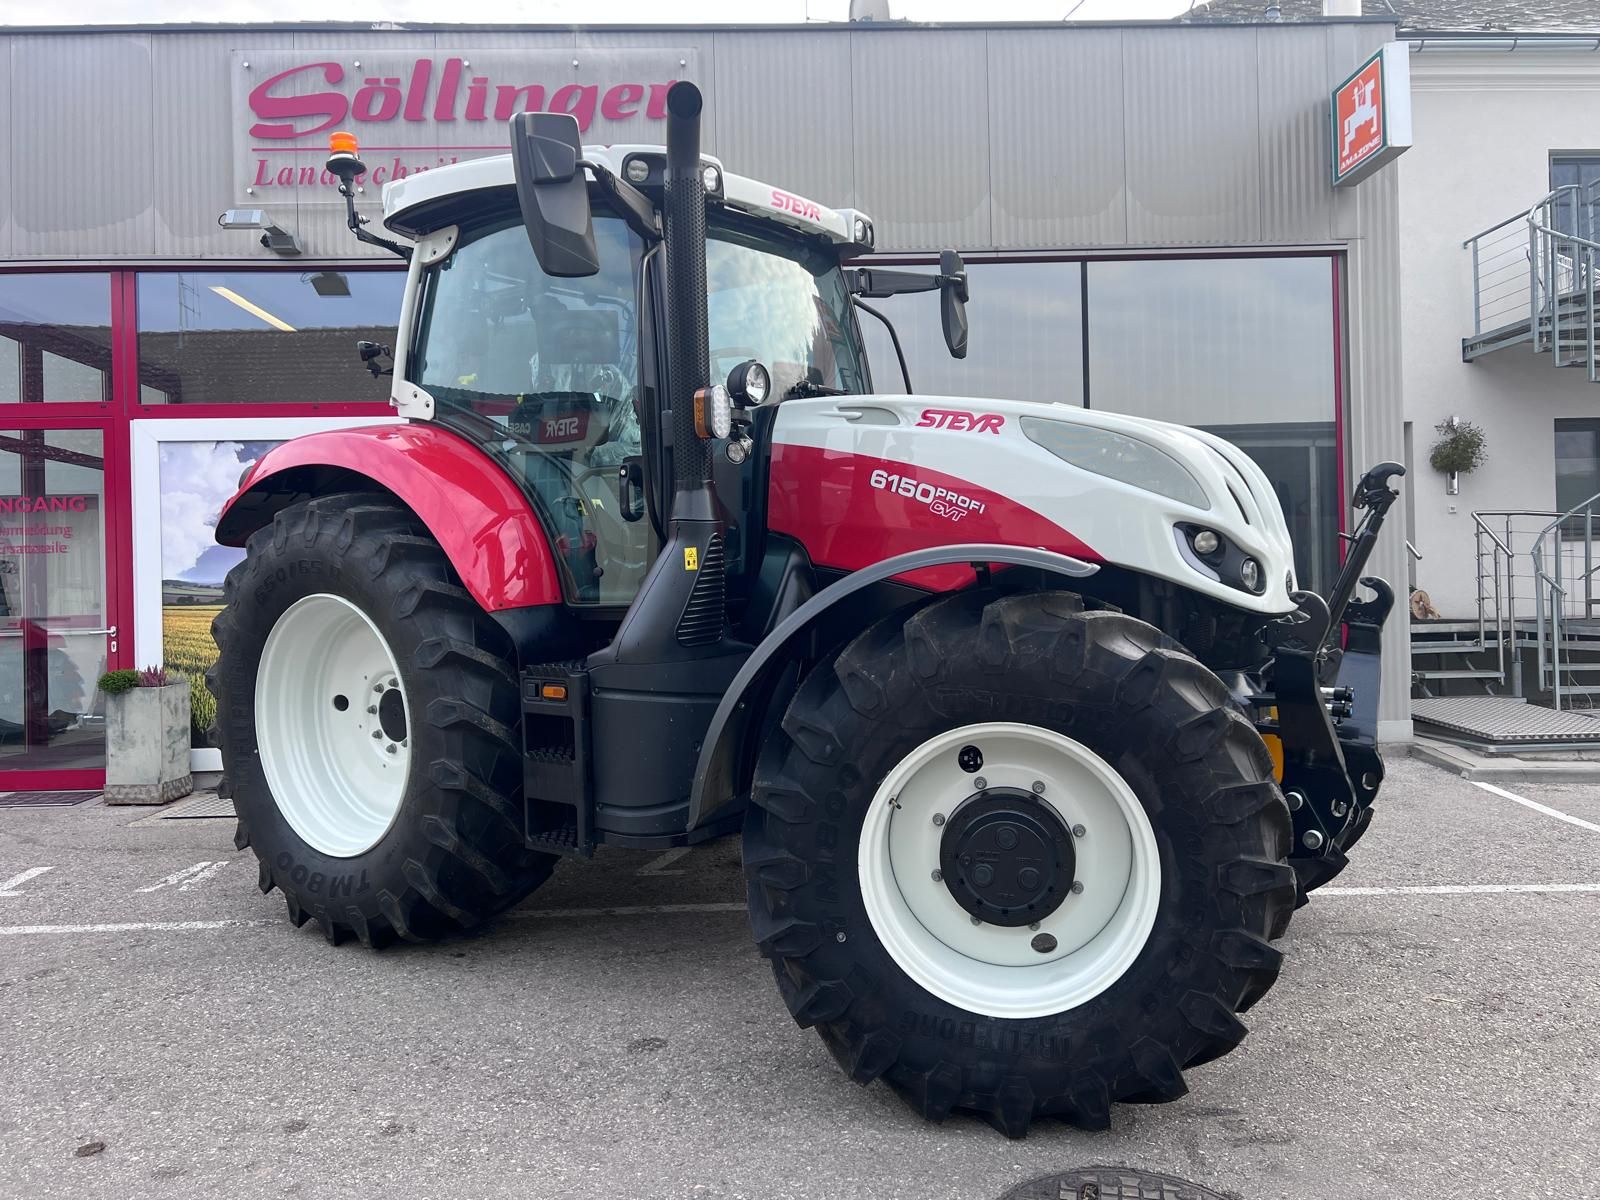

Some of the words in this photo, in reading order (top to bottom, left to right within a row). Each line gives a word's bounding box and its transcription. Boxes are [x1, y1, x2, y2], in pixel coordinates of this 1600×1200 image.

[248, 58, 678, 138] Söllinger
[1340, 134, 1381, 170] AMAZONE
[770, 190, 821, 222] STEYR
[915, 409, 1005, 435] STEYR
[870, 469, 937, 504] 6150
[935, 487, 986, 514] PROFI
[929, 499, 968, 522] CVT
